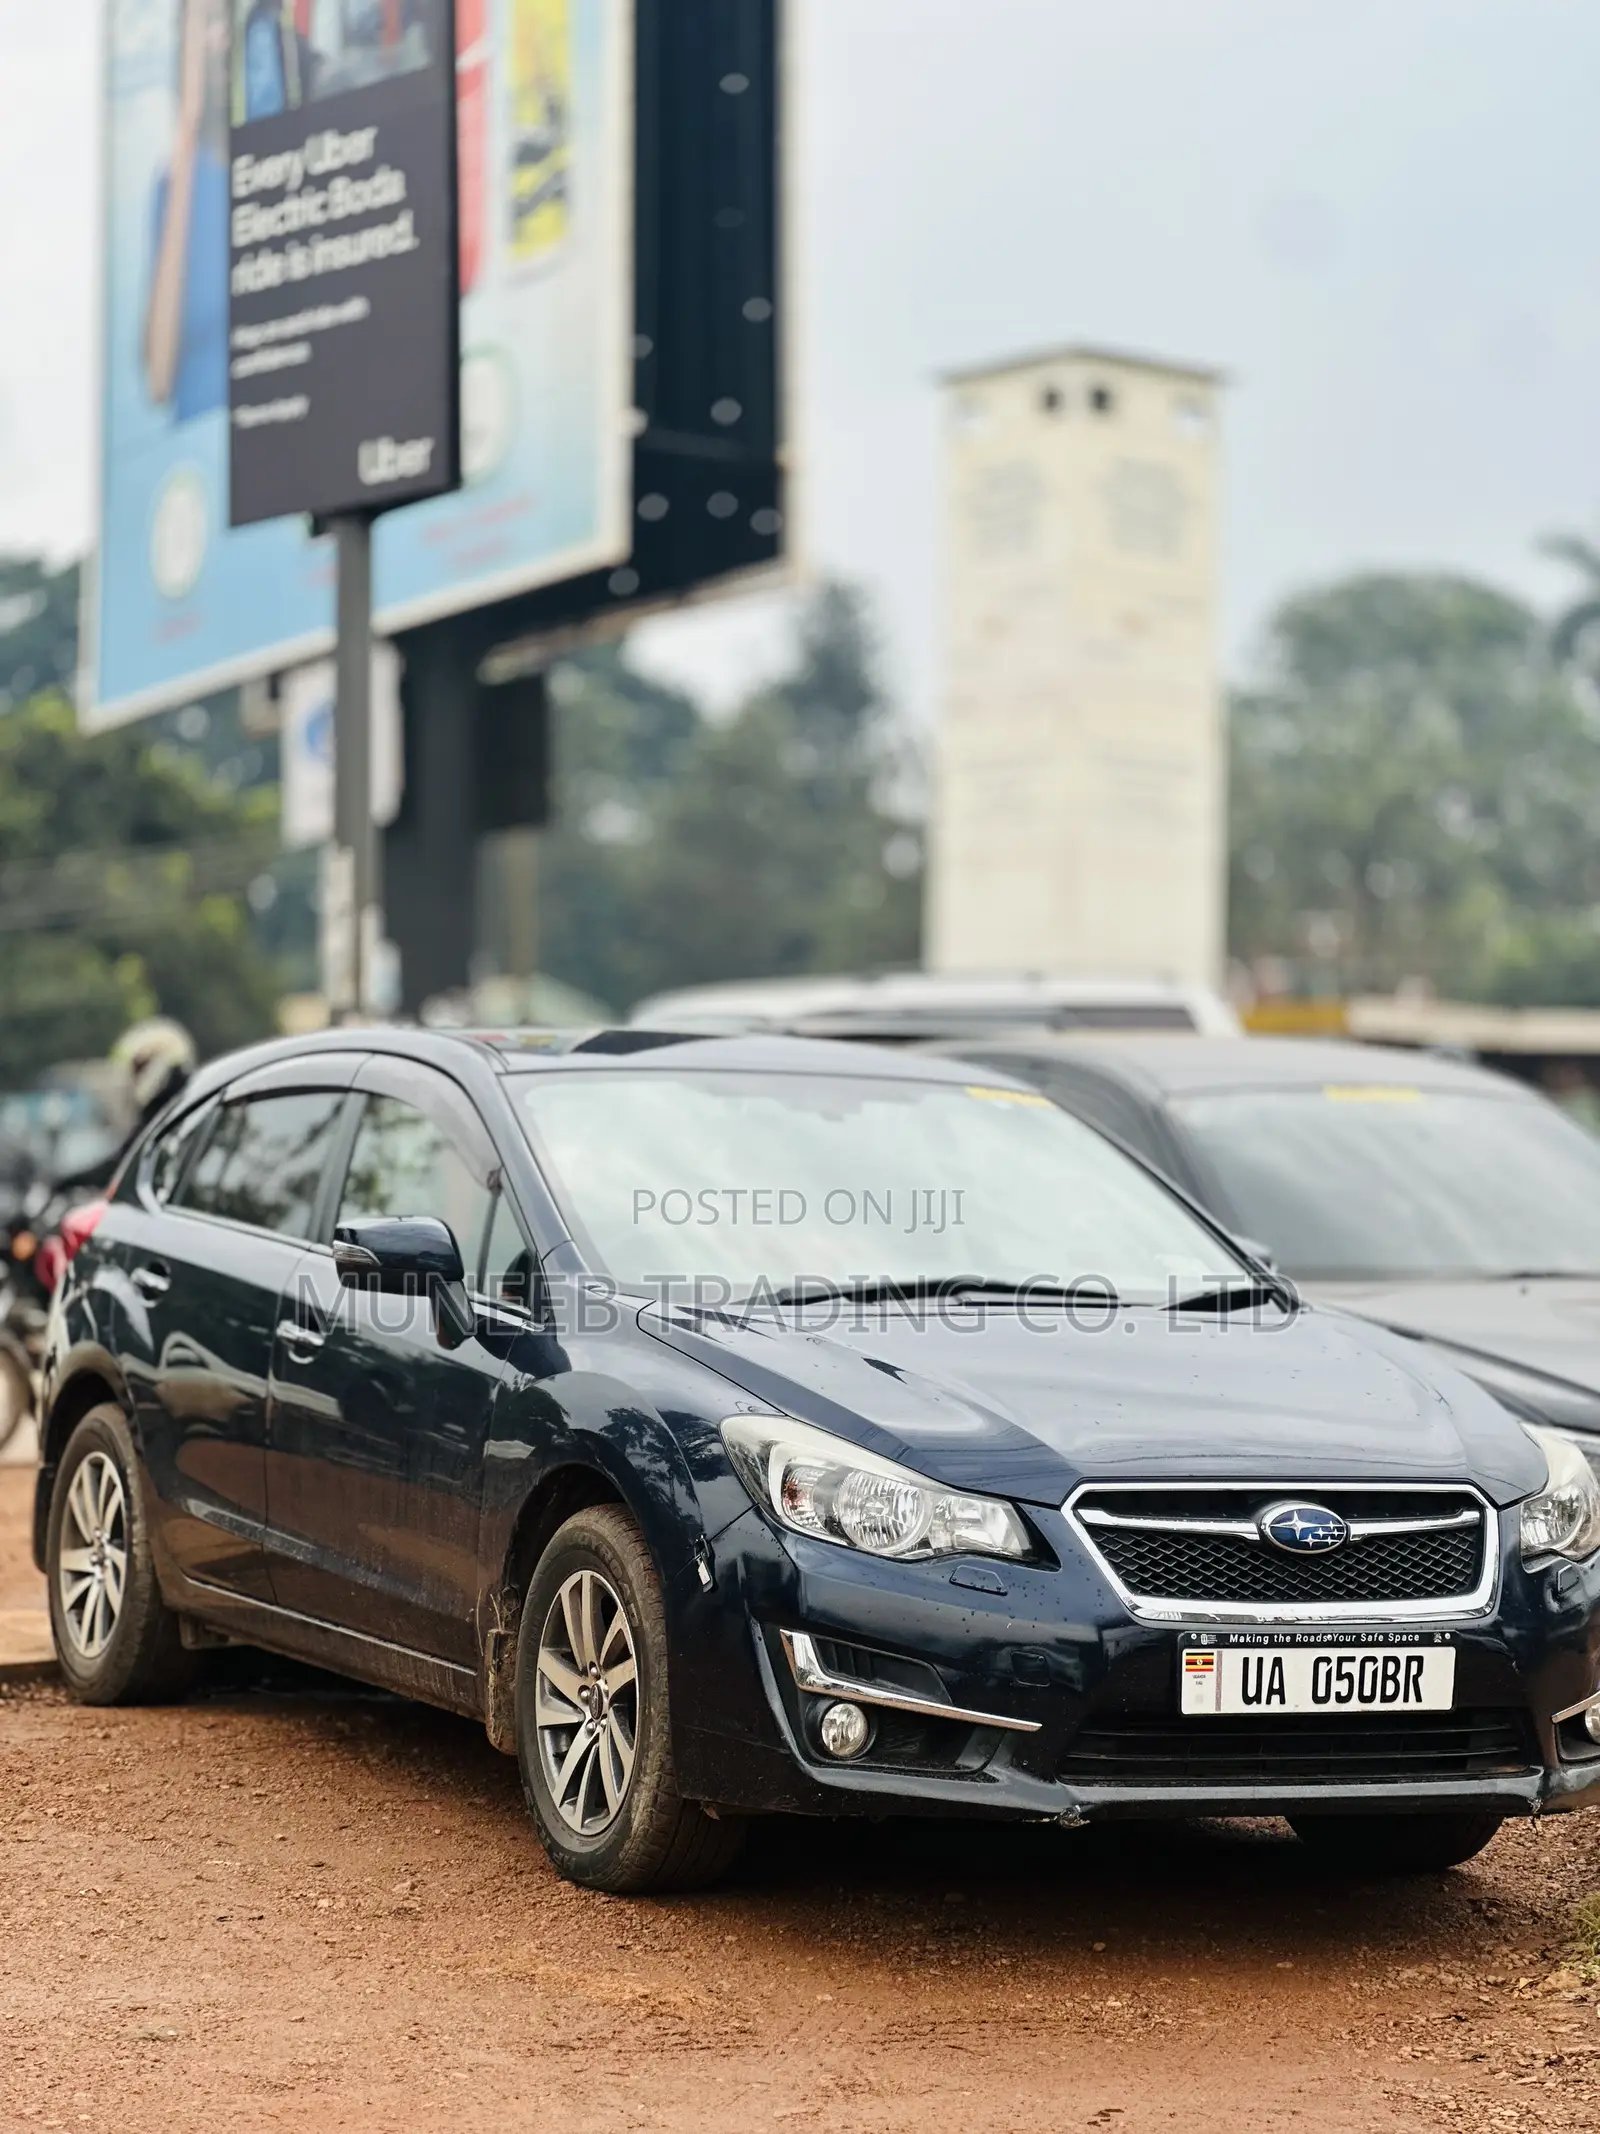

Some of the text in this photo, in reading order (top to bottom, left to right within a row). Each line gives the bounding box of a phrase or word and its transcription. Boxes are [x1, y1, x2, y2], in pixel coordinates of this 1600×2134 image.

[305, 125, 379, 176] Uber
[232, 186, 328, 248] Electric
[357, 436, 435, 485] Uber
[1229, 1633, 1269, 1645] Making
[1273, 1633, 1292, 1643] the
[1295, 1633, 1328, 1643] Roads
[1332, 1633, 1357, 1642] Your
[1360, 1632, 1385, 1642] Safe
[1388, 1632, 1420, 1644] Space
[1241, 1655, 1424, 1705] UA 050BR
